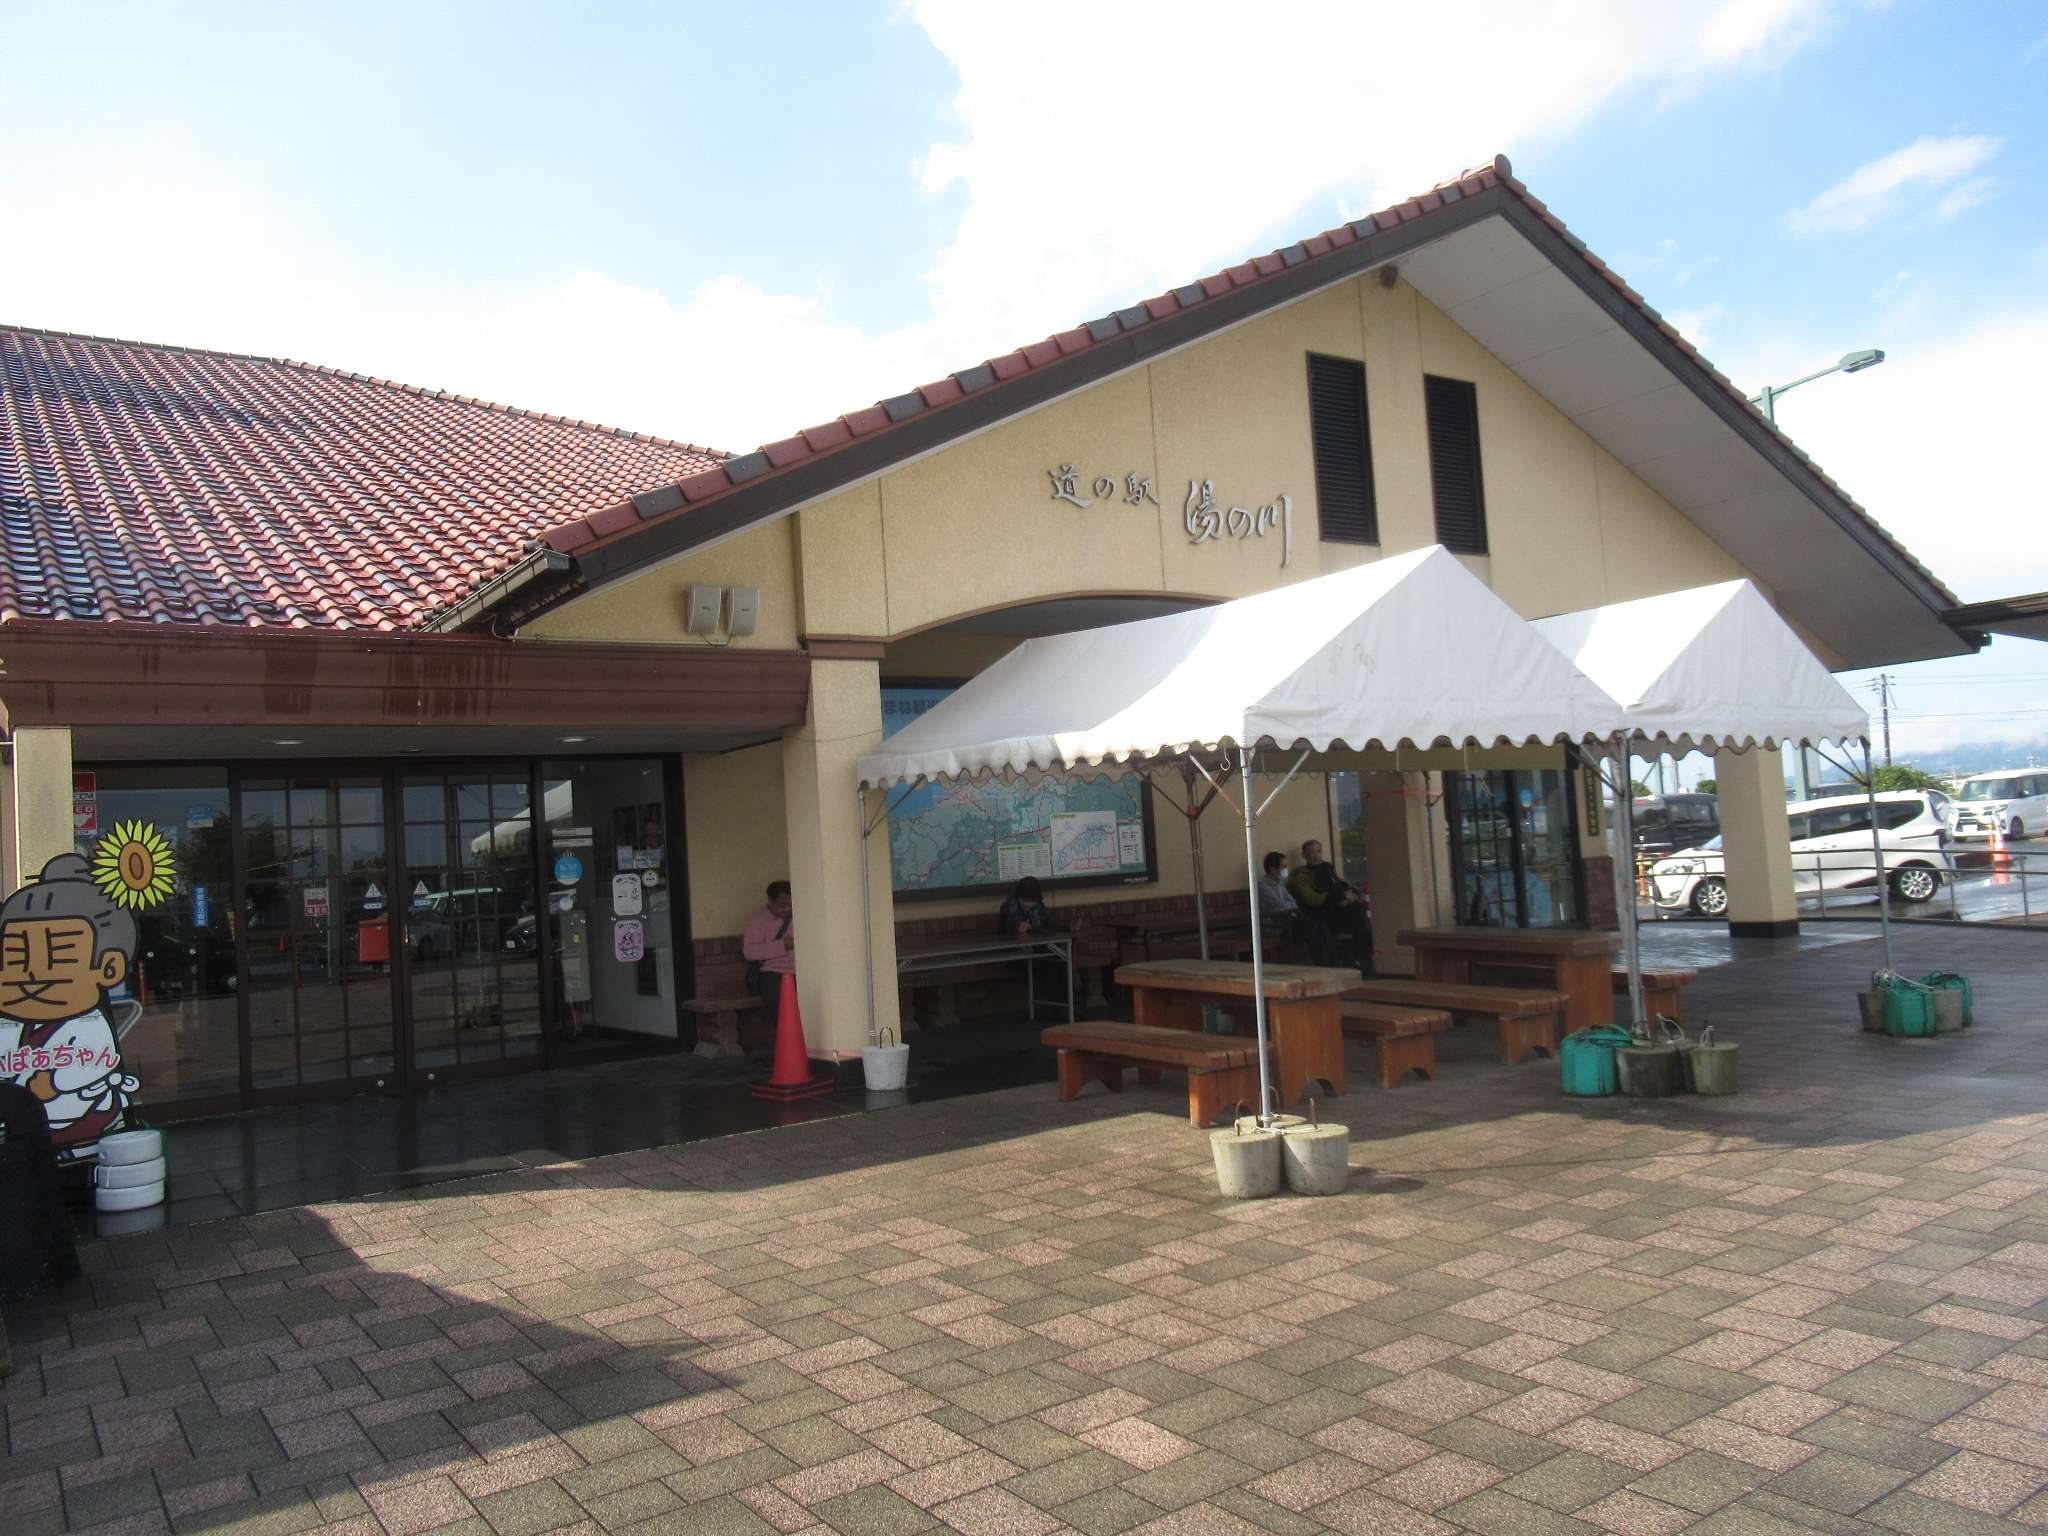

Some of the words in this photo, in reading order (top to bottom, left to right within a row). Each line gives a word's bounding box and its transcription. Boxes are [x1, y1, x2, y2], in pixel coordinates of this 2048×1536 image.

[1048, 463, 1161, 509] 道の駅
[1184, 479, 1294, 568] 湯の川
